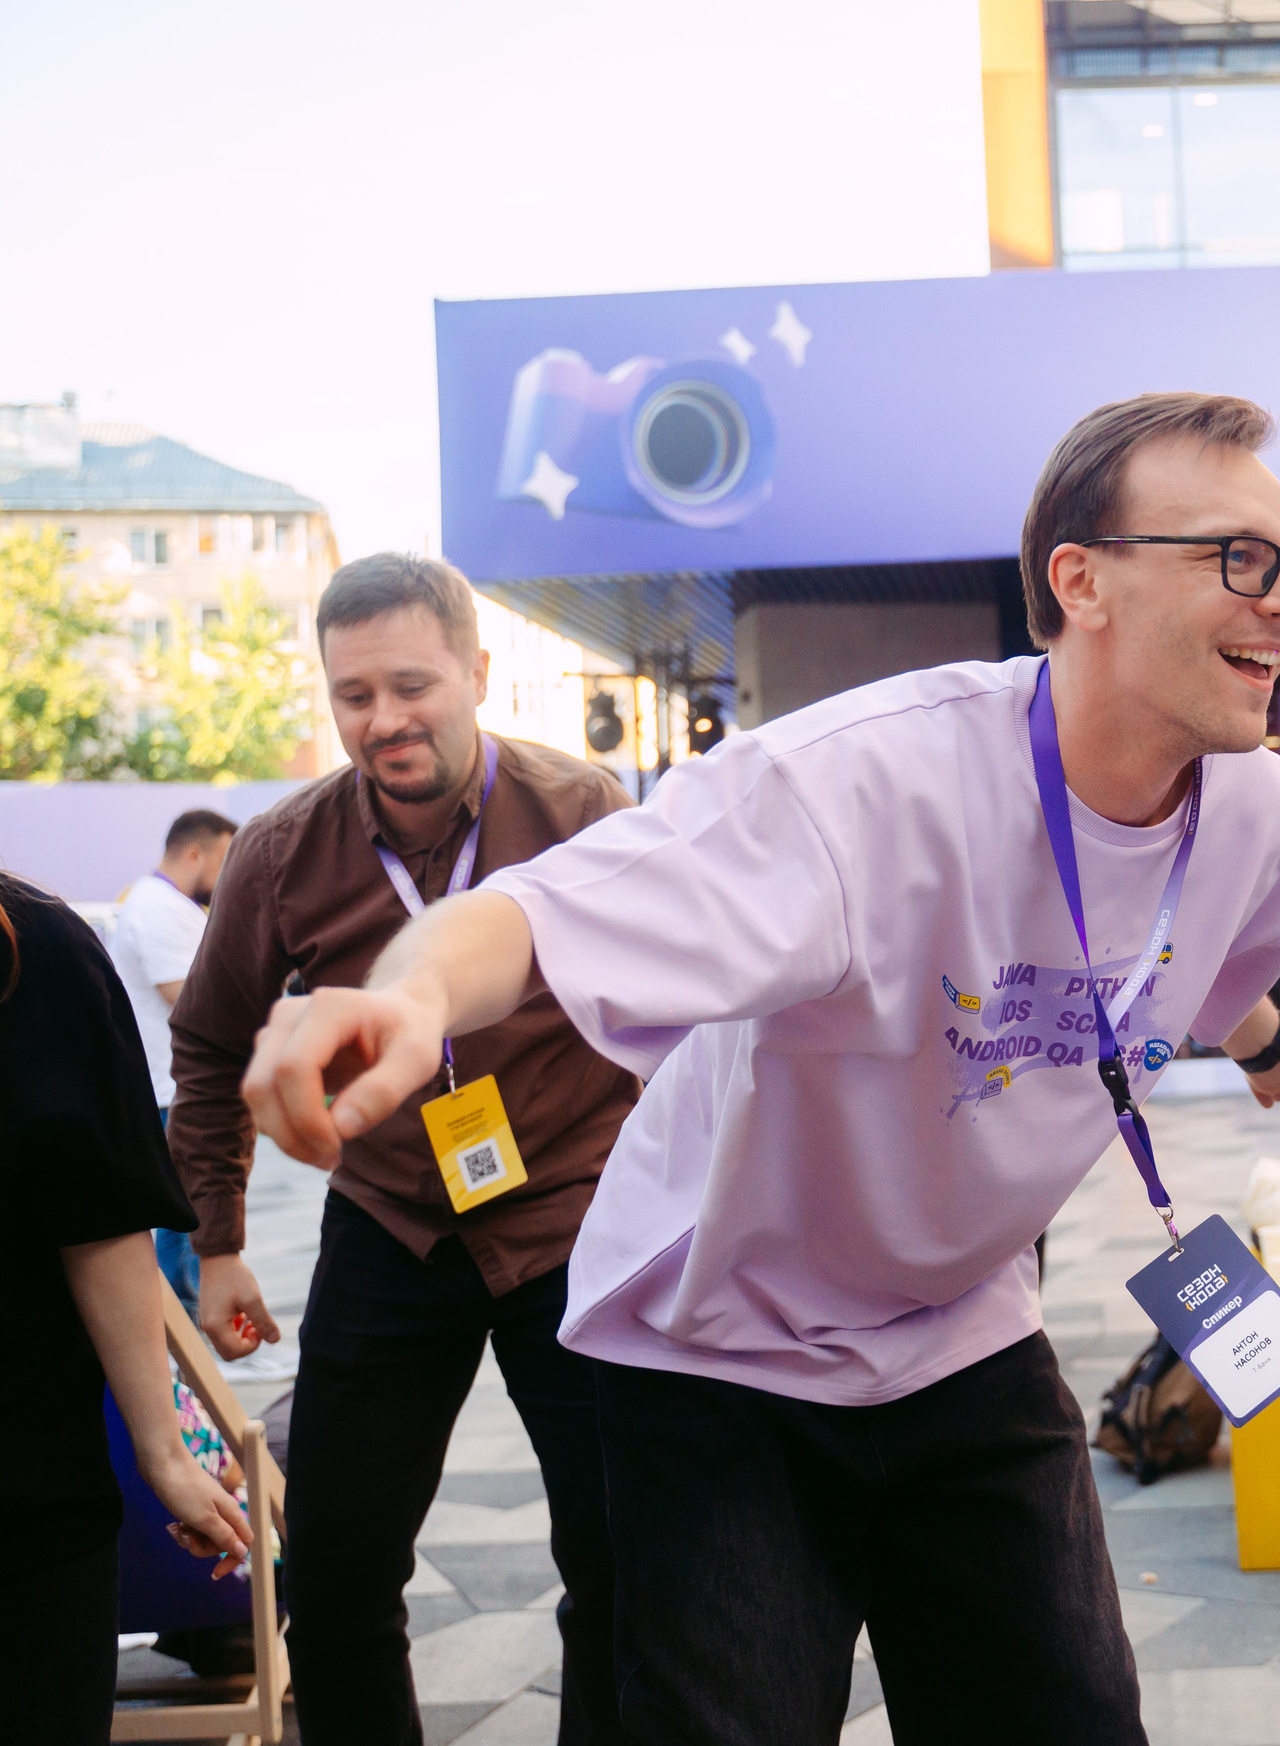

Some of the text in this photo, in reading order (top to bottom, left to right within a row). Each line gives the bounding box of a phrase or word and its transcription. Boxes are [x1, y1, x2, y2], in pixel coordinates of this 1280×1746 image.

[992, 963, 1037, 989] JAVA
[1064, 976, 1156, 999] PYTHN
[999, 1000, 1033, 1024] IOS
[1056, 1011, 1130, 1034] SCA
[944, 1026, 1042, 1061] ANDROID
[1046, 1042, 1084, 1067] QA
[1202, 1295, 1243, 1330] Спикер
[1232, 1331, 1259, 1356] АНТОН
[1233, 1337, 1272, 1370] НАСОНОВ
